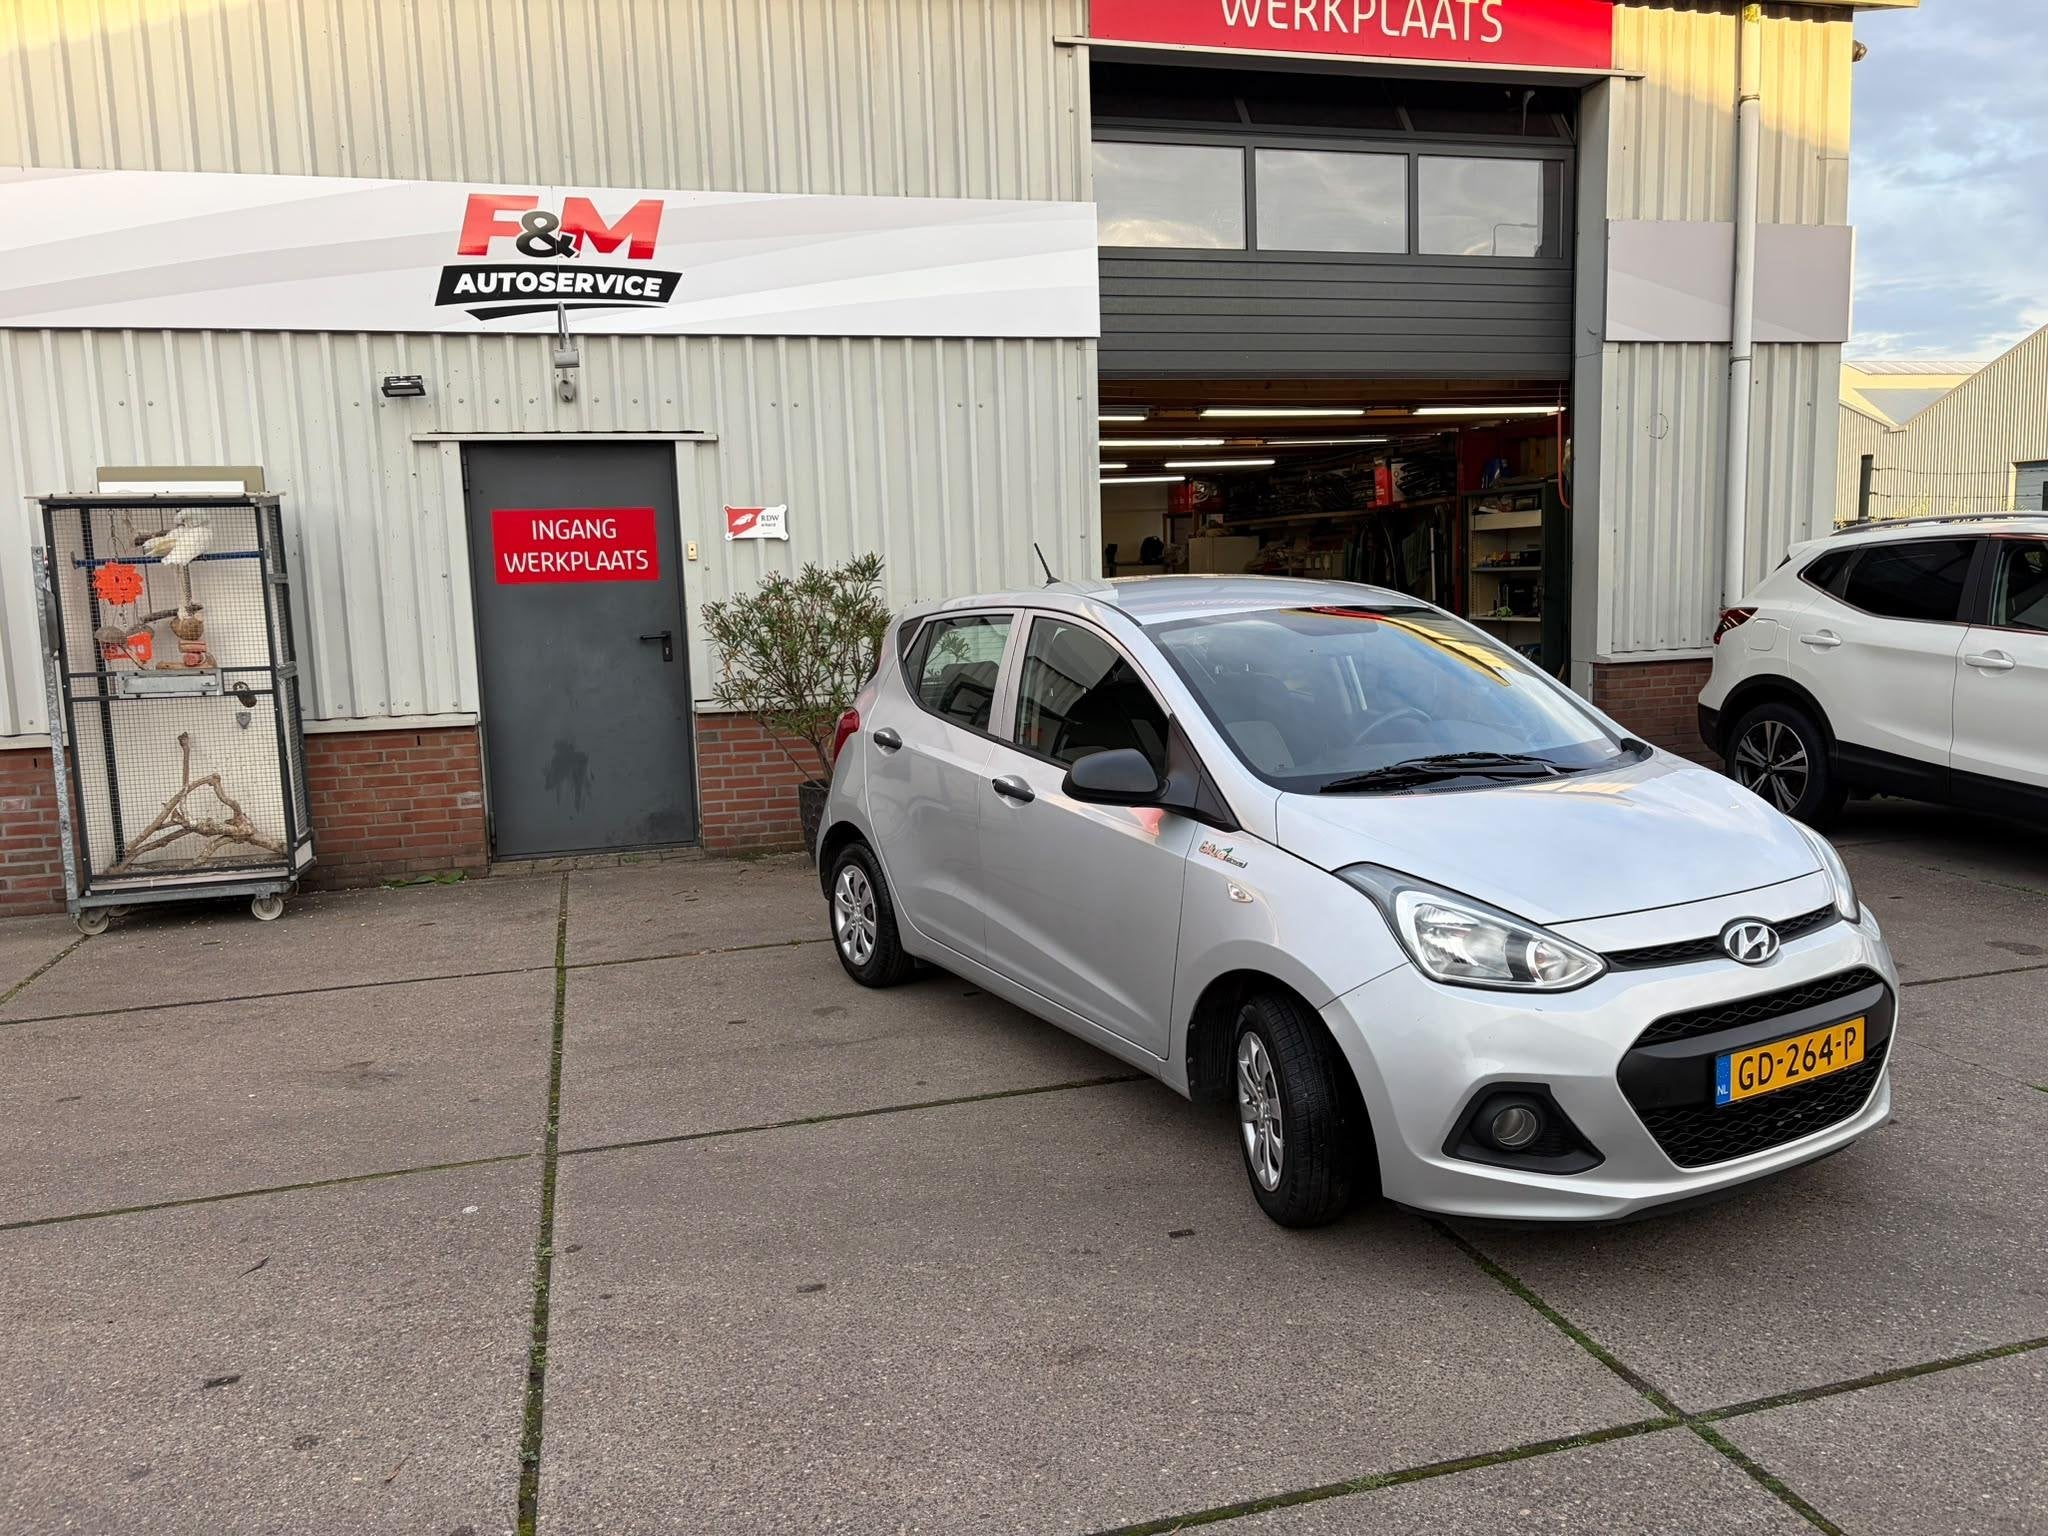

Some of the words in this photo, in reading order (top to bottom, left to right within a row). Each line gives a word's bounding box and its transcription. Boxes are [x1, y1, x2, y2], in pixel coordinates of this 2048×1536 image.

[1220, 0, 1504, 43] WERKPLAATS
[457, 193, 665, 260] F&M
[453, 271, 663, 298] AUTOSERVICE
[531, 518, 617, 540] INGANG
[760, 514, 780, 522] RDW
[503, 549, 649, 573] WERKPLAATS
[1738, 1026, 1857, 1091] GD-264-P
[1717, 1085, 1729, 1095] NL
